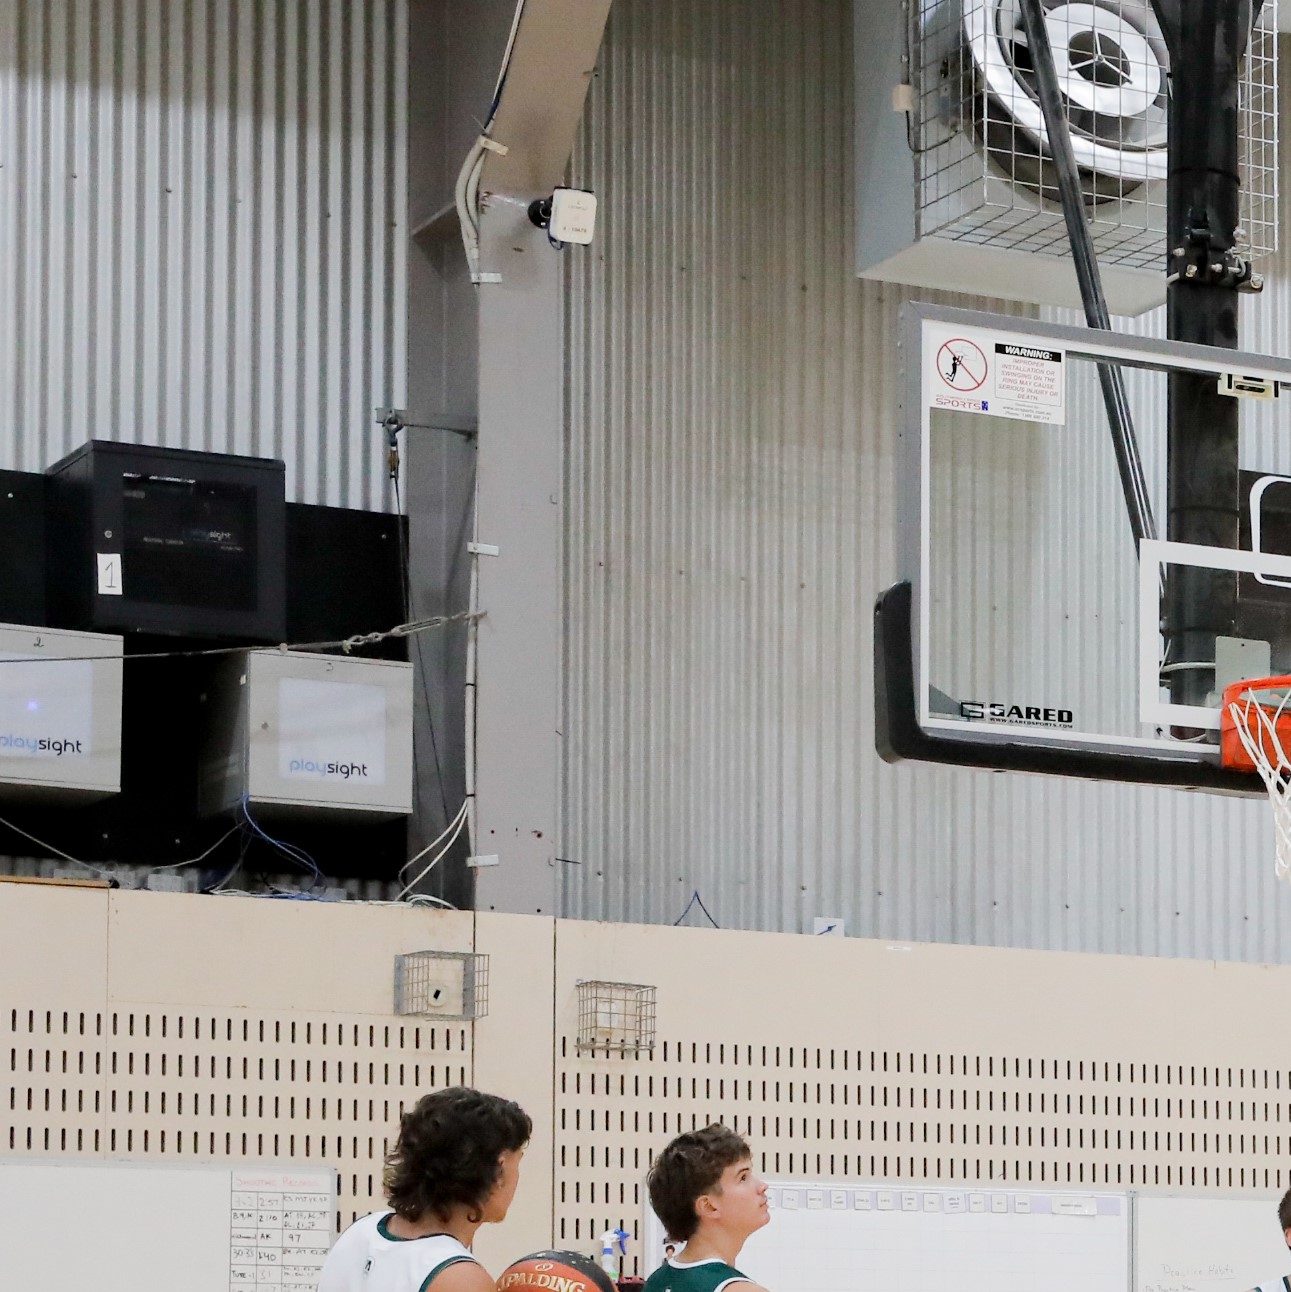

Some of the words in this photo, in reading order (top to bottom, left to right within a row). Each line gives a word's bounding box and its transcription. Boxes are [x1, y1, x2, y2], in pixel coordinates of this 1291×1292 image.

[1005, 345, 1053, 361] WARNING:
[1001, 363, 1045, 375] INSTALLATION
[1046, 369, 1056, 377] OR
[1013, 358, 1045, 368] IMPROPER
[1000, 370, 1032, 380] SWINGING
[1044, 376, 1056, 384] THE
[1002, 377, 1018, 386] RING
[1019, 379, 1032, 387] MAY
[1033, 381, 1054, 390] CAUSE
[998, 383, 1025, 393] SERIOUS
[1026, 387, 1049, 397] INJURY
[1017, 392, 1038, 401] DEATH
[936, 397, 981, 411] SPORTS
[105, 561, 117, 588] 1
[989, 703, 1073, 723] GARED
[289, 758, 368, 779] playsight
